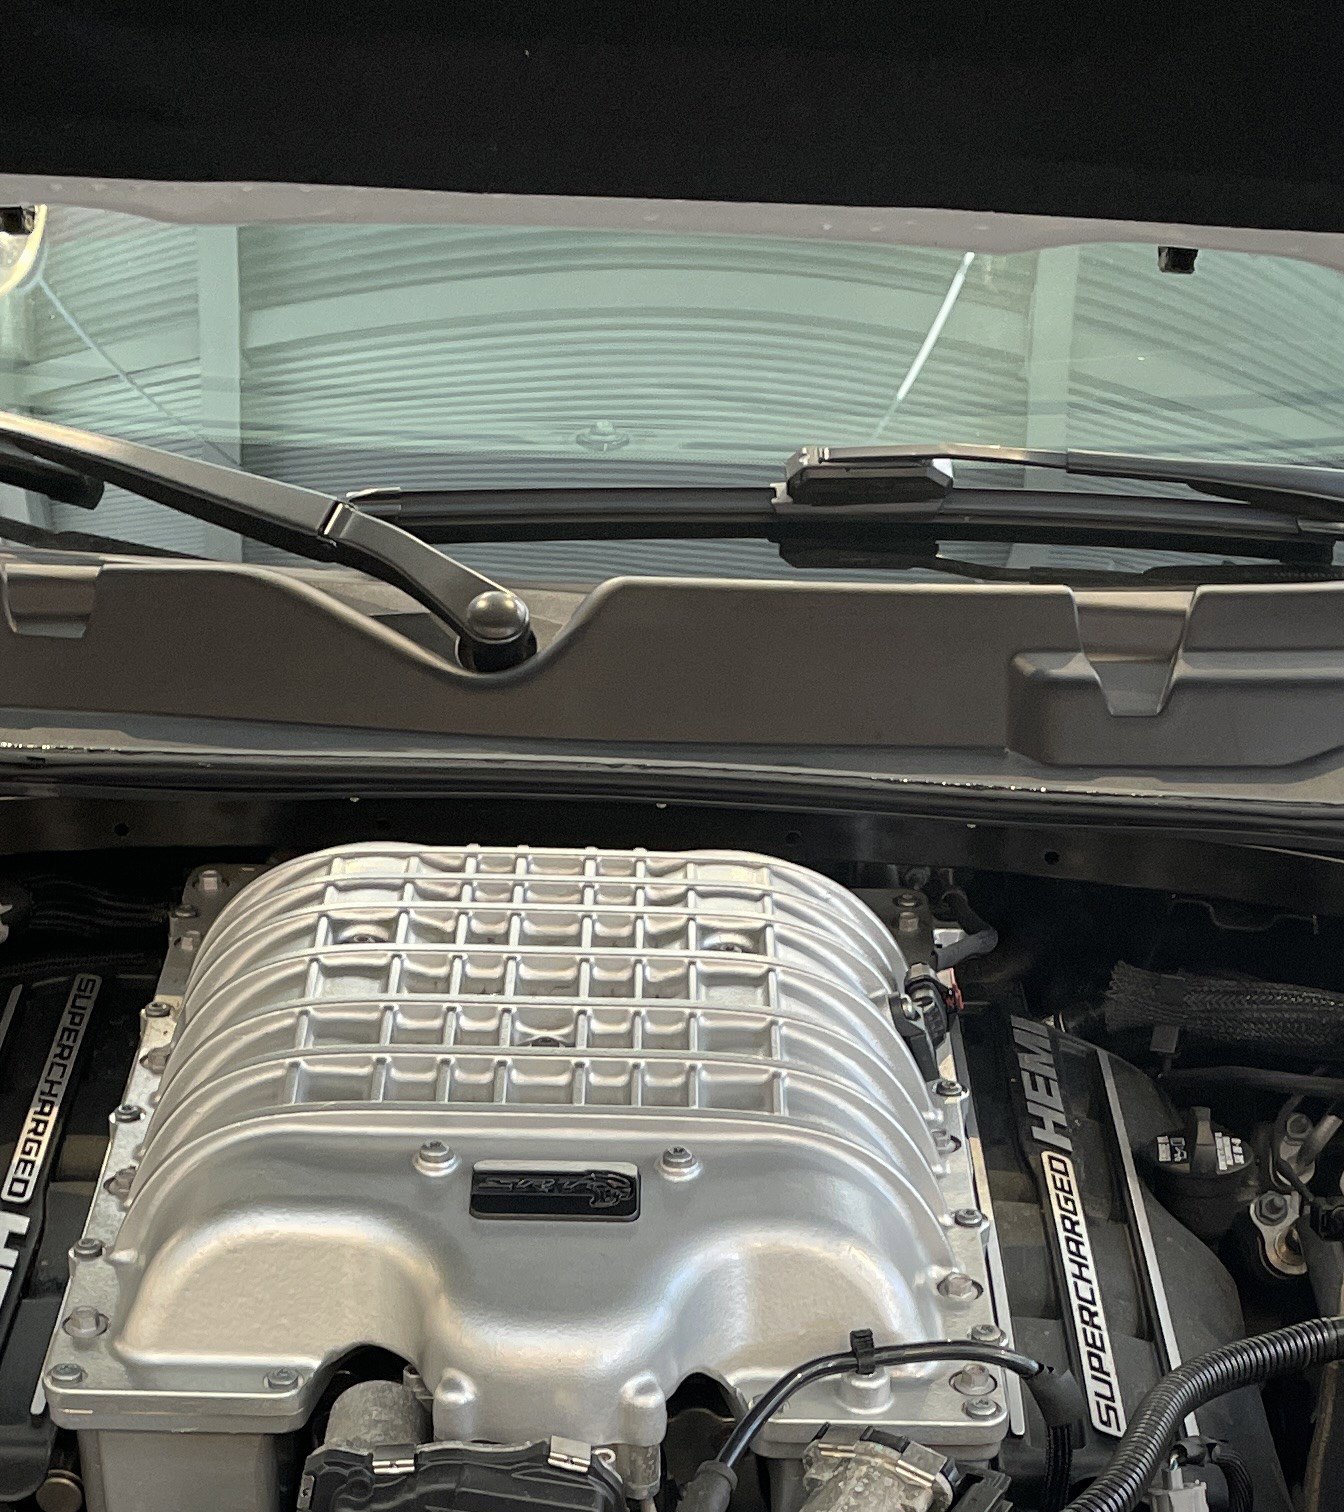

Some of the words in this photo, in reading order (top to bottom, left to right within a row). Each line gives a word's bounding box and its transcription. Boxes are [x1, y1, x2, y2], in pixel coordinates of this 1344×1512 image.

[7, 976, 97, 1198] SUPERCHARGED
[1010, 1014, 1074, 1152] HEMI
[1047, 1154, 1121, 1433] SUPERCHARGED
